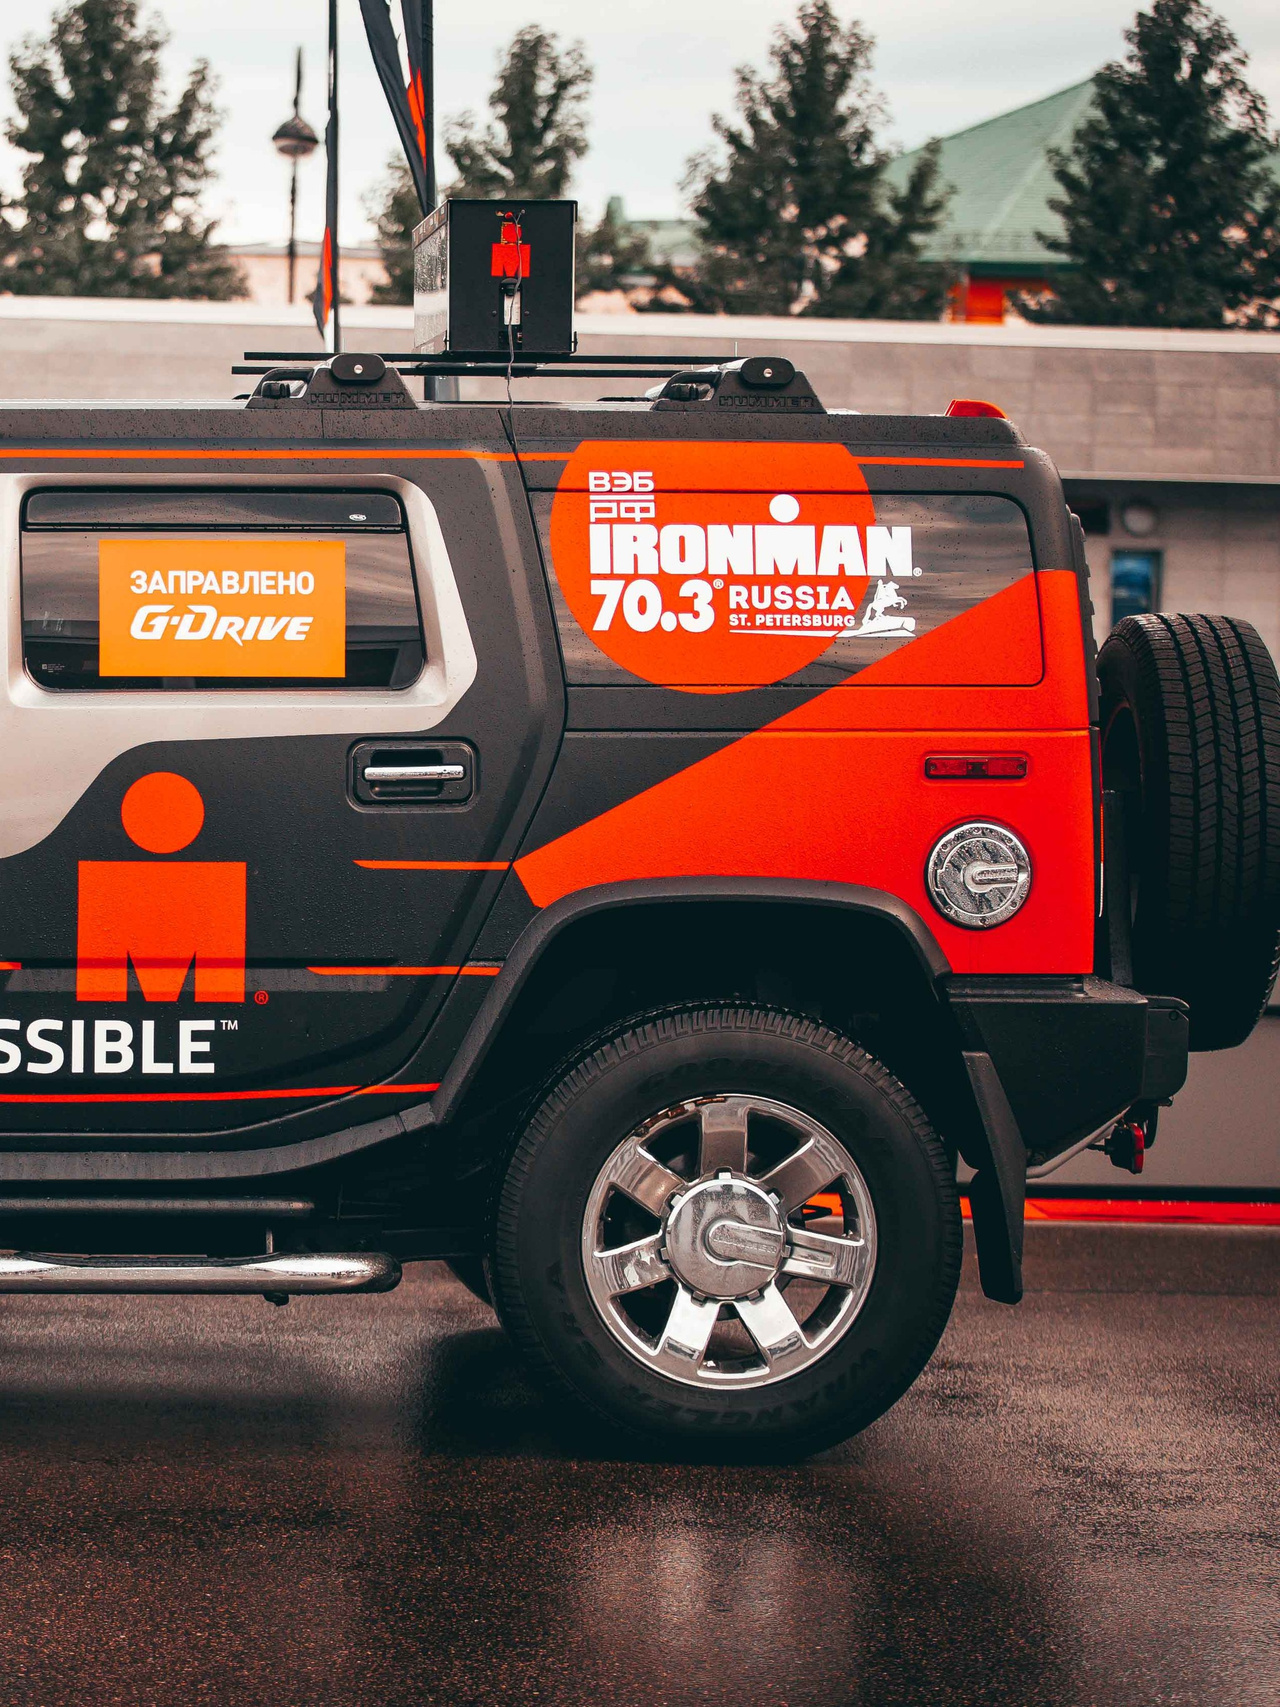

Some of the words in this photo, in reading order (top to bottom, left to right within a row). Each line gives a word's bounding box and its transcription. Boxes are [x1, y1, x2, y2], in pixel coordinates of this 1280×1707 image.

[589, 471, 654, 492] ВЭБ
[589, 502, 655, 522] РФ
[588, 524, 913, 577] IRONMAN
[130, 570, 315, 595] ЗАПРАВЛЕНО
[590, 579, 715, 633] 70.3
[729, 585, 855, 610] RUSSIA
[729, 614, 752, 627] ST.
[756, 614, 856, 628] PETERSBURG
